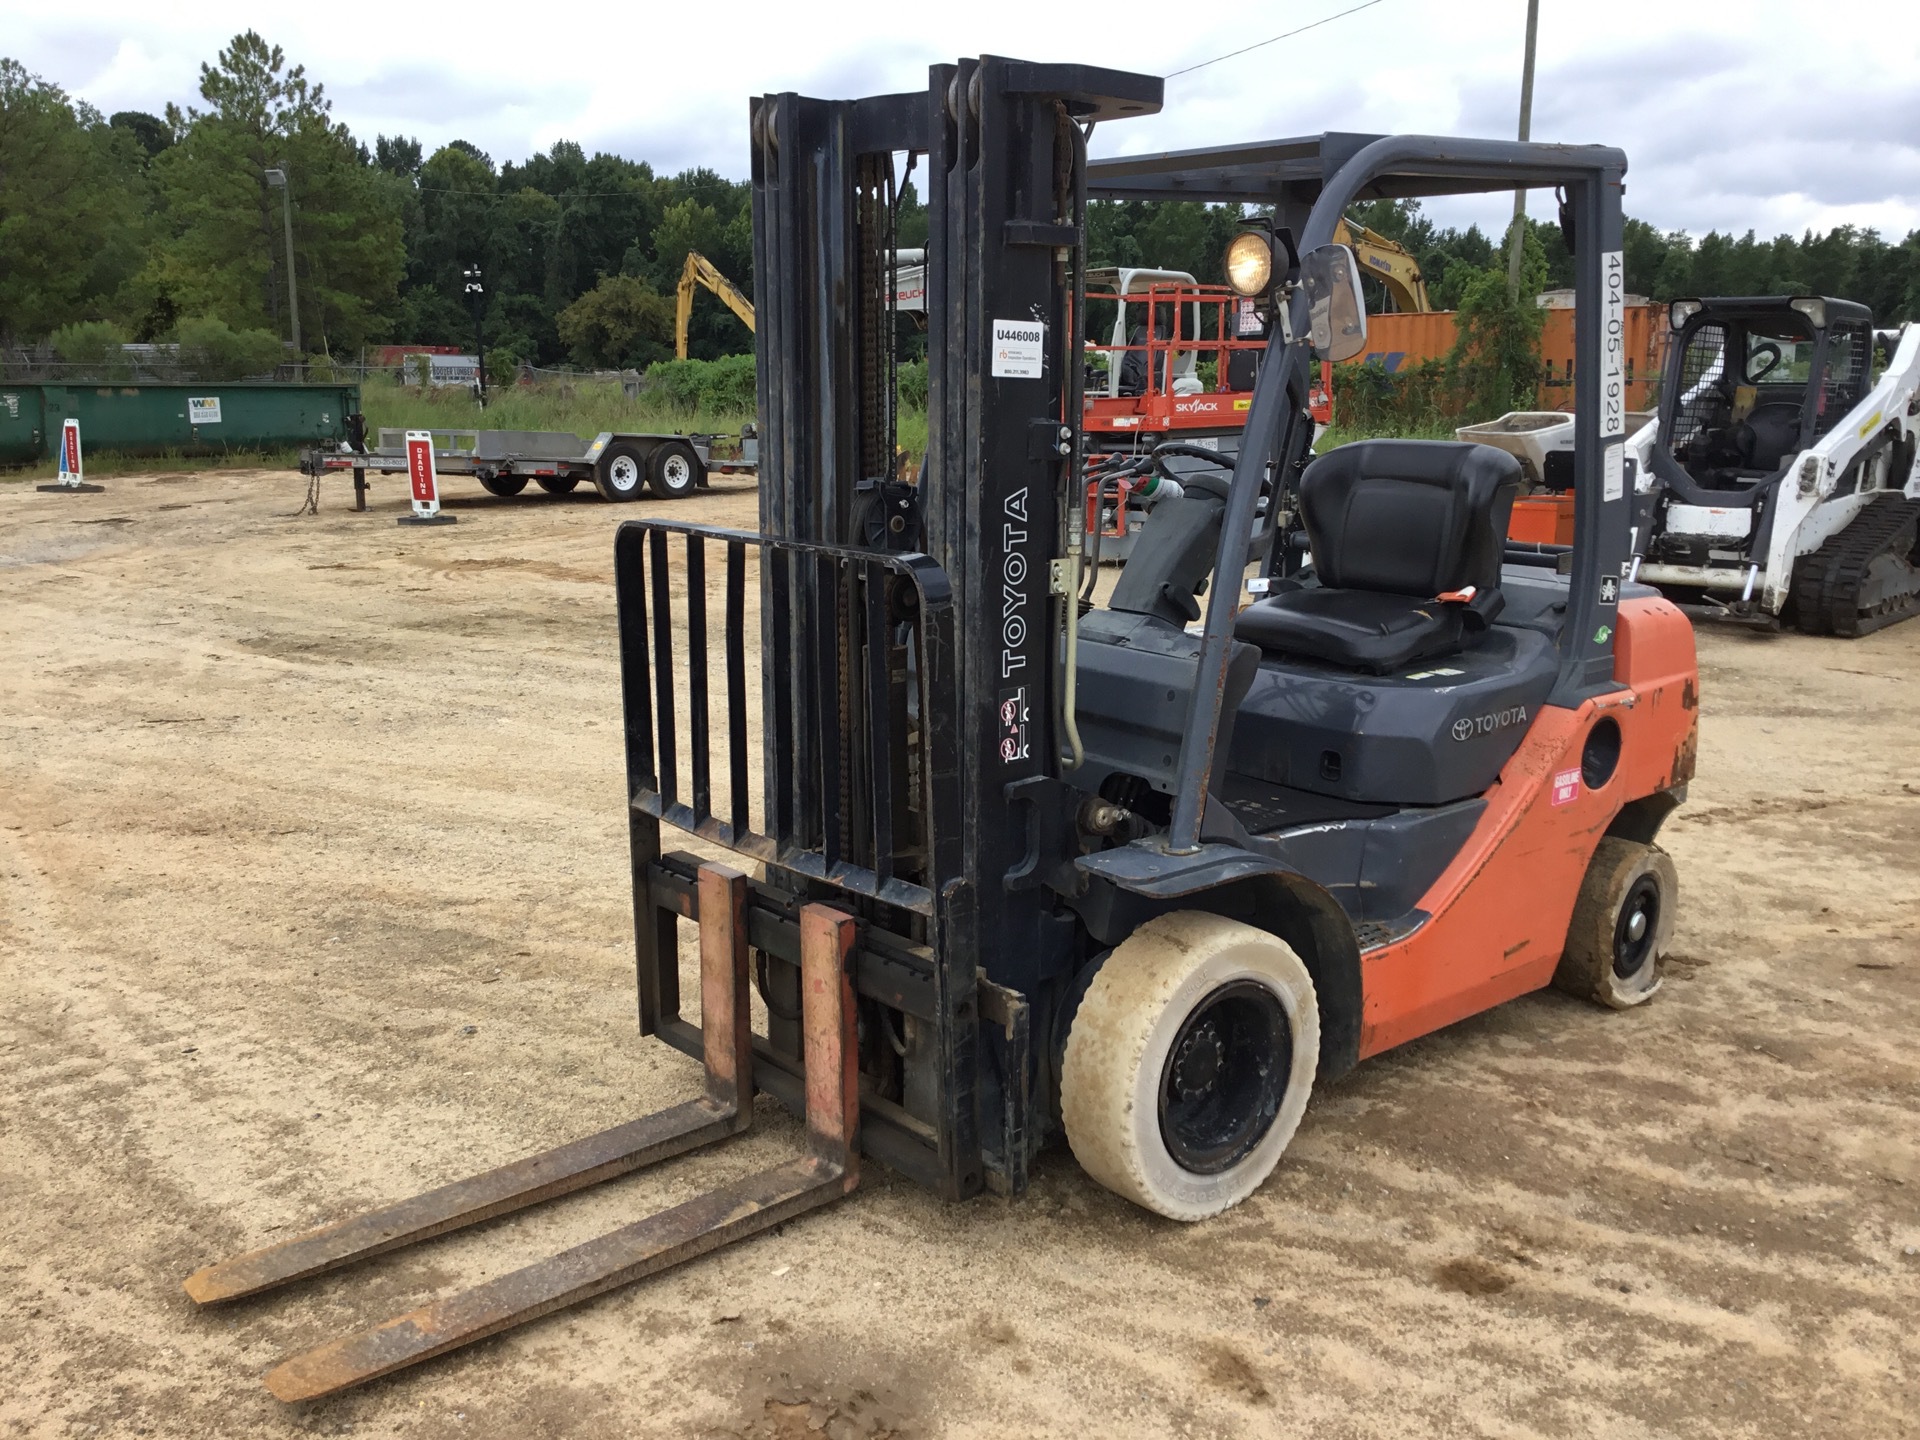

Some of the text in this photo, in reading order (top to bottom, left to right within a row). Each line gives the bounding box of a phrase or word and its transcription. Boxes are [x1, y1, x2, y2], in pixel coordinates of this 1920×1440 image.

[1369, 255, 1392, 273] KOMATSU
[997, 329, 1040, 343] U446008
[1605, 254, 1622, 433] 404-05-1928
[1175, 398, 1218, 413] SKYJACK
[416, 447, 427, 495] DEADLINE
[1002, 486, 1029, 679] TOYOTA
[1476, 706, 1527, 733] TOYOTA
